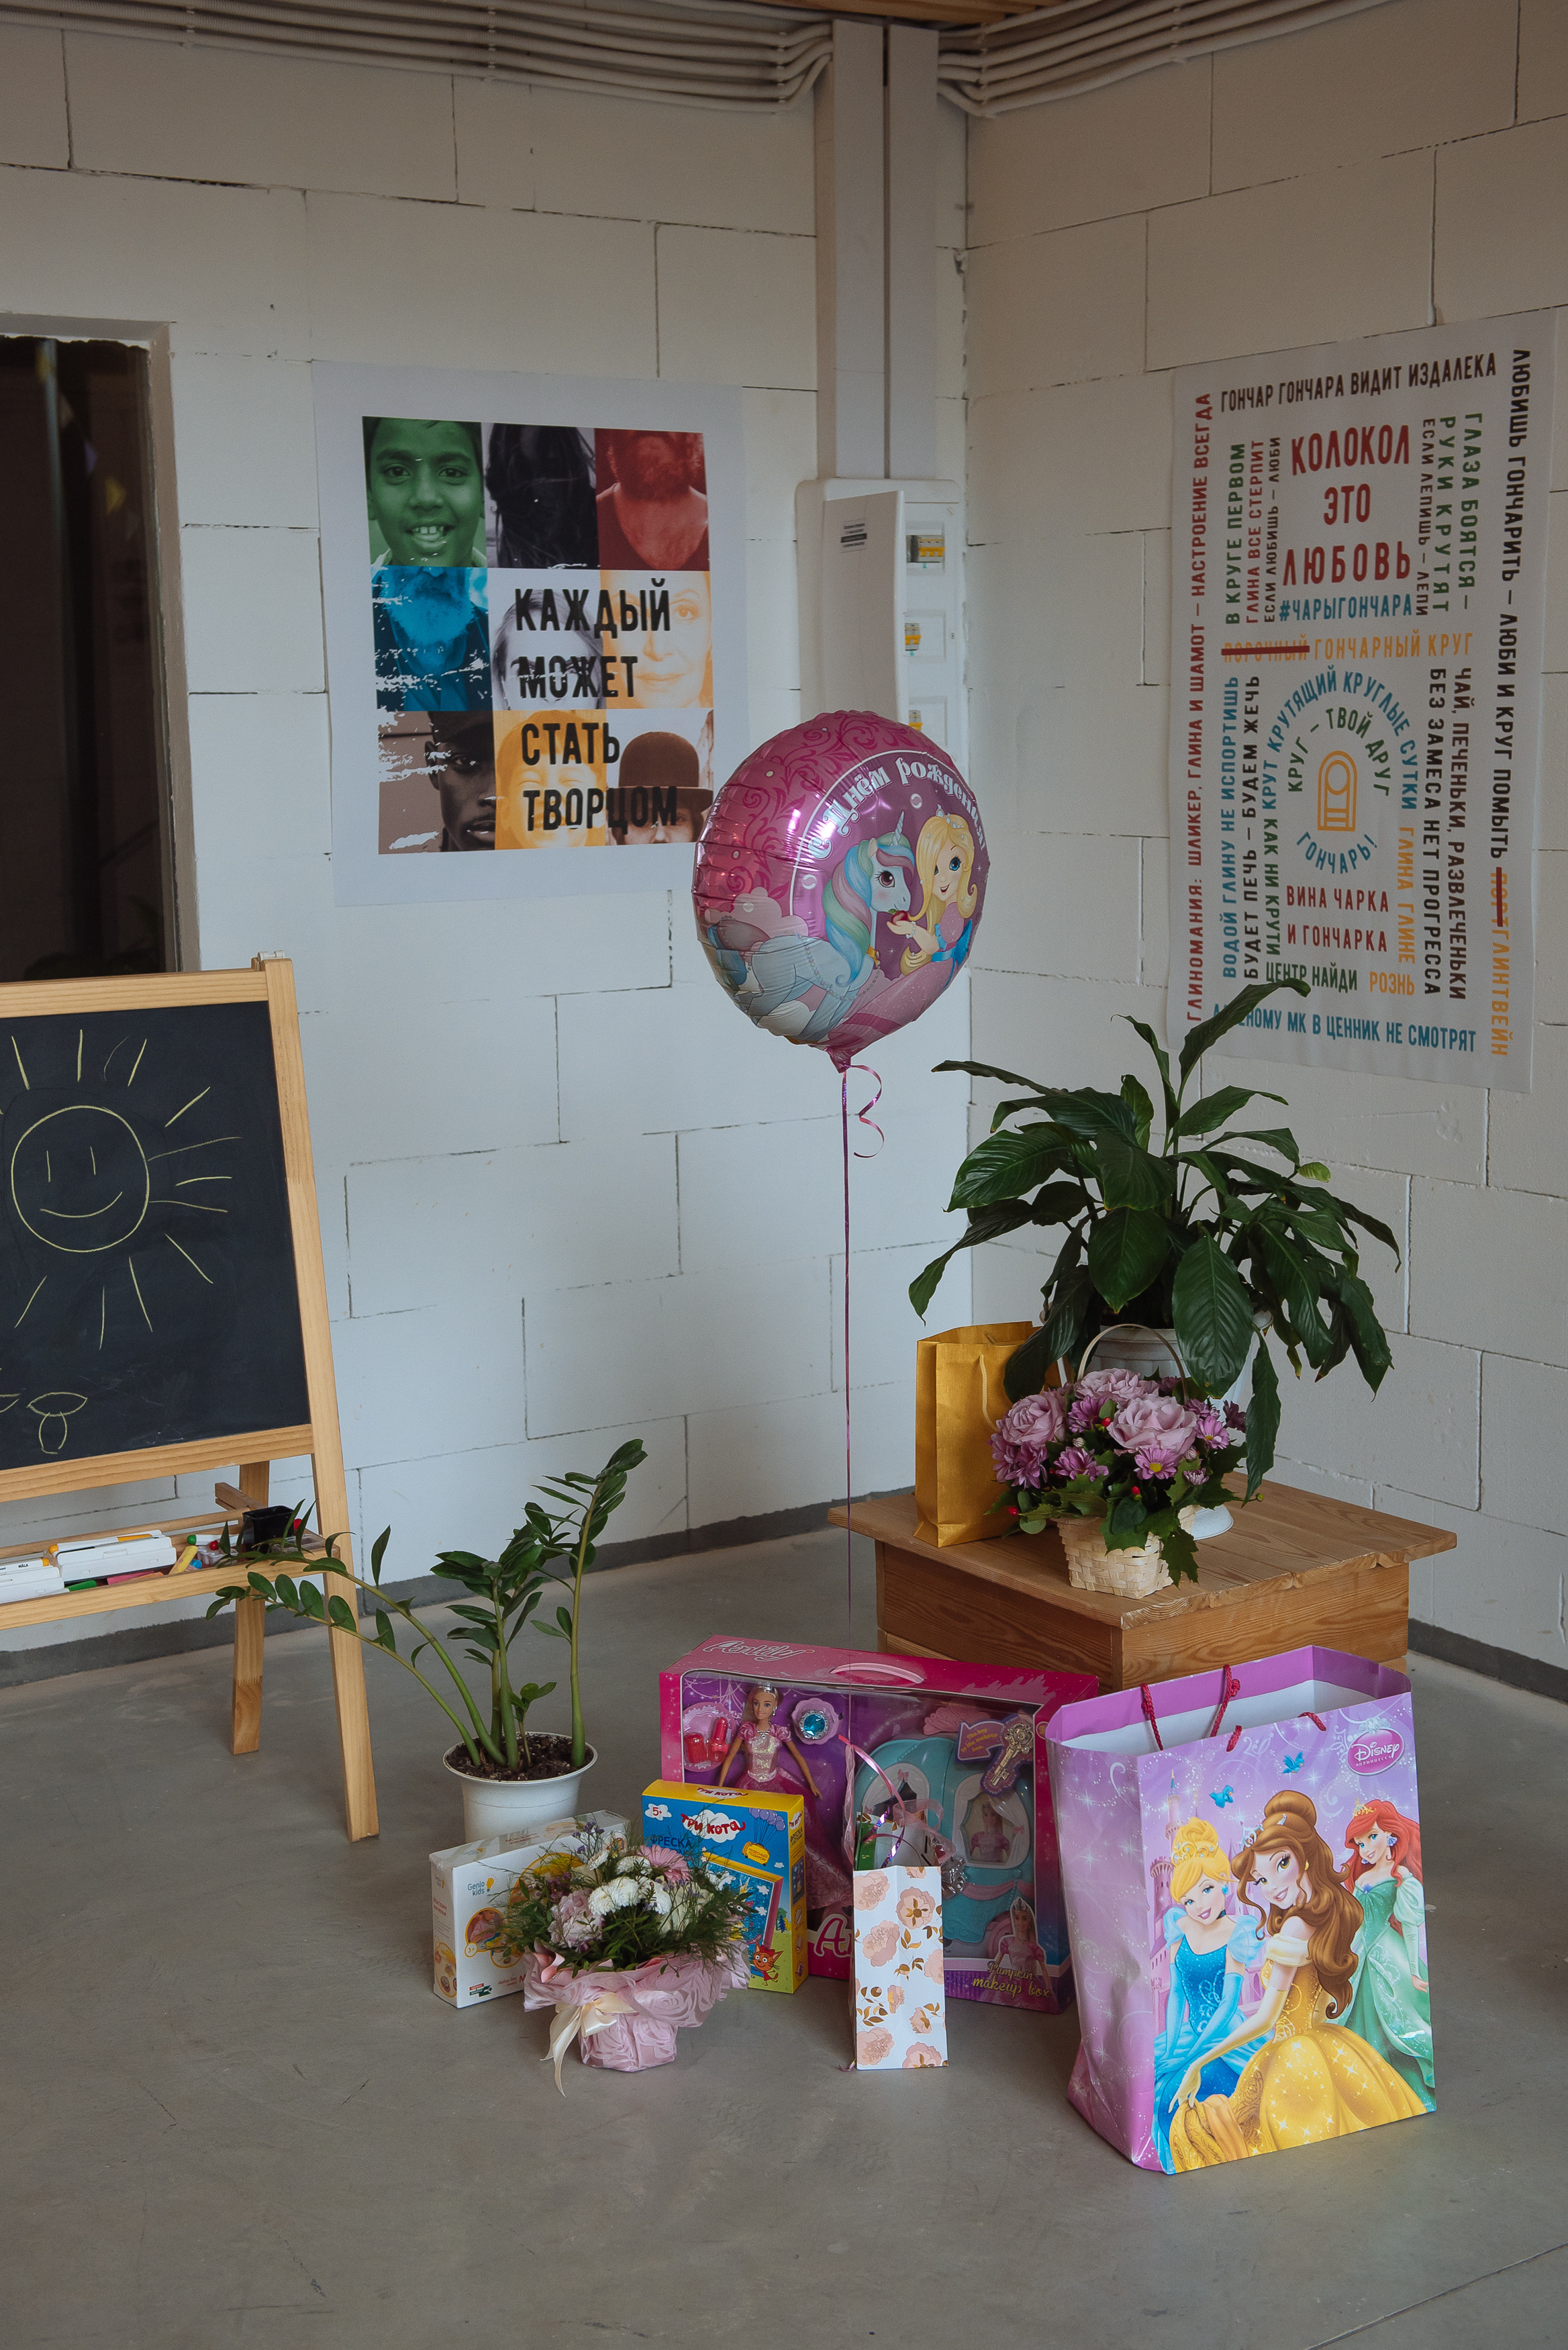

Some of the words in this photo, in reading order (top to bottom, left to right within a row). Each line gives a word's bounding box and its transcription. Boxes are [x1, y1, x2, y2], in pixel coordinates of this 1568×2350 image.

[1221, 384, 1274, 413] ГОНЧАР
[1278, 374, 1344, 405] ГОНЧАРА
[1350, 365, 1402, 397] ВИДИТ
[1408, 352, 1496, 389] ИЗДАЛЕКА
[1508, 349, 1531, 448] ЛЮБИШЬ
[1193, 393, 1213, 469] ВСЕГДА
[1268, 436, 1281, 483] ЛЮБИ
[1291, 424, 1410, 476] КОЛОКОЛ
[1421, 418, 1436, 465] ЕСЛИ
[1436, 416, 1457, 490] РУКИ
[1461, 412, 1483, 490] ГЛАЗА
[1227, 443, 1245, 530] ПЕРВОМ
[1248, 440, 1264, 519] СТЕРПИТ
[1323, 483, 1371, 526] ЭТО
[1191, 475, 1208, 597] НАСТРОЕНИЕ
[1418, 473, 1434, 546] ЛЕПИШЬ
[1501, 456, 1526, 582] ГОНЧАРИТЬ
[1247, 526, 1261, 559] ВСЕ
[1265, 506, 1279, 575] ЛЮБИШЬ
[1282, 540, 1411, 586] ЛЮБОВЬ
[1432, 504, 1453, 612] КРУТЯТ
[1458, 499, 1479, 588] БОЯТСЯ
[1226, 538, 1242, 604] КРУГЕ
[1246, 566, 1261, 624] ГЛИНА
[1415, 571, 1430, 616] ЛЕПИ
[515, 577, 671, 639] КАЖДЫЙ
[1225, 612, 1240, 624] В
[1263, 582, 1277, 623] ЕСЛИ
[1279, 594, 1412, 622] #ЧАРЫГОНЧАРА
[1189, 623, 1205, 692] ШАМОТ
[1314, 628, 1420, 660] ГОНЧАРНЫЙ
[1428, 632, 1473, 657] КРУГ
[1497, 613, 1518, 675] ЛЮБИ
[518, 655, 638, 699] МОЖЕТ
[1189, 700, 1204, 712] И
[1243, 676, 1260, 735] ЖЕЧЬ
[1342, 671, 1410, 737] КРУГЛЫЕ
[1428, 668, 1447, 709] БЕЗ
[1451, 667, 1475, 714] ЧАЙ,
[1496, 684, 1516, 698] И
[1267, 664, 1337, 753] КРУТЯЩИЙ
[1493, 706, 1514, 760] КРУГ
[522, 722, 620, 765] СТАТЬ
[1187, 719, 1203, 779] ГЛИНА
[1221, 677, 1238, 800] ИСПОРТИШЬ
[1287, 736, 1308, 792] КРУГ
[1325, 706, 1373, 739] ТВОЙ
[1365, 739, 1391, 796] ДРУГ
[1424, 718, 1445, 810] ЗАМЕСА
[1241, 744, 1259, 818] БУДЕМ
[1261, 759, 1278, 810] КРУТ
[1400, 739, 1418, 810] СУТКИ
[1446, 722, 1470, 833] ПЕЧЕНЬКИ,
[523, 786, 677, 835] ТВОРЦОМ
[1187, 786, 1203, 866] ШЛИКЕР,
[1220, 808, 1235, 832] НЕ
[1263, 818, 1279, 855] КАК
[1422, 819, 1440, 860] НЕТ
[1490, 769, 1512, 859] ПОМЫТЬ
[1221, 840, 1237, 904] ГЛИНУ
[1242, 849, 1259, 902] ПЕЧЬ
[1264, 863, 1279, 888] НИ
[1296, 831, 1378, 875] ГОНЧАРЬ!
[1397, 827, 1414, 890] ГЛИНА
[1265, 894, 1281, 955] КРУТИ
[1286, 885, 1327, 908] ВИНА
[1333, 888, 1389, 912] ЧАРКА
[1447, 841, 1467, 1000] РАЗВЛЕЧЕНЬКИ
[1186, 879, 1204, 1022] ГЛИНОМАНИЯ:
[1219, 912, 1240, 978] ВОДОЙ
[1243, 910, 1261, 980] БУДЕТ
[1287, 923, 1296, 945] И
[1302, 925, 1387, 953] ГОНЧАРКА
[1398, 903, 1416, 964] ГЛИНЕ
[1422, 869, 1442, 995] ПРОГРЕССА
[1266, 961, 1307, 983] ЦЕНТР
[1312, 961, 1358, 994] НАЙДИ
[1369, 971, 1415, 996] РОЗНЬ
[1287, 1011, 1307, 1034] МК
[1312, 1014, 1322, 1035] В
[1326, 1015, 1381, 1042] ЦЕННИК
[1386, 1021, 1403, 1044] НЕ
[1408, 1024, 1477, 1053] СМОТРЯТ
[652, 1806, 663, 1816] 5+
[650, 1834, 693, 1849] ФРЕСКА
[467, 1881, 485, 1891] Genio
[472, 1888, 485, 1896] kids
[972, 1977, 1022, 2000] makeup
[1028, 1981, 1053, 1999] box
[987, 1960, 1034, 1981] Pumpkin
